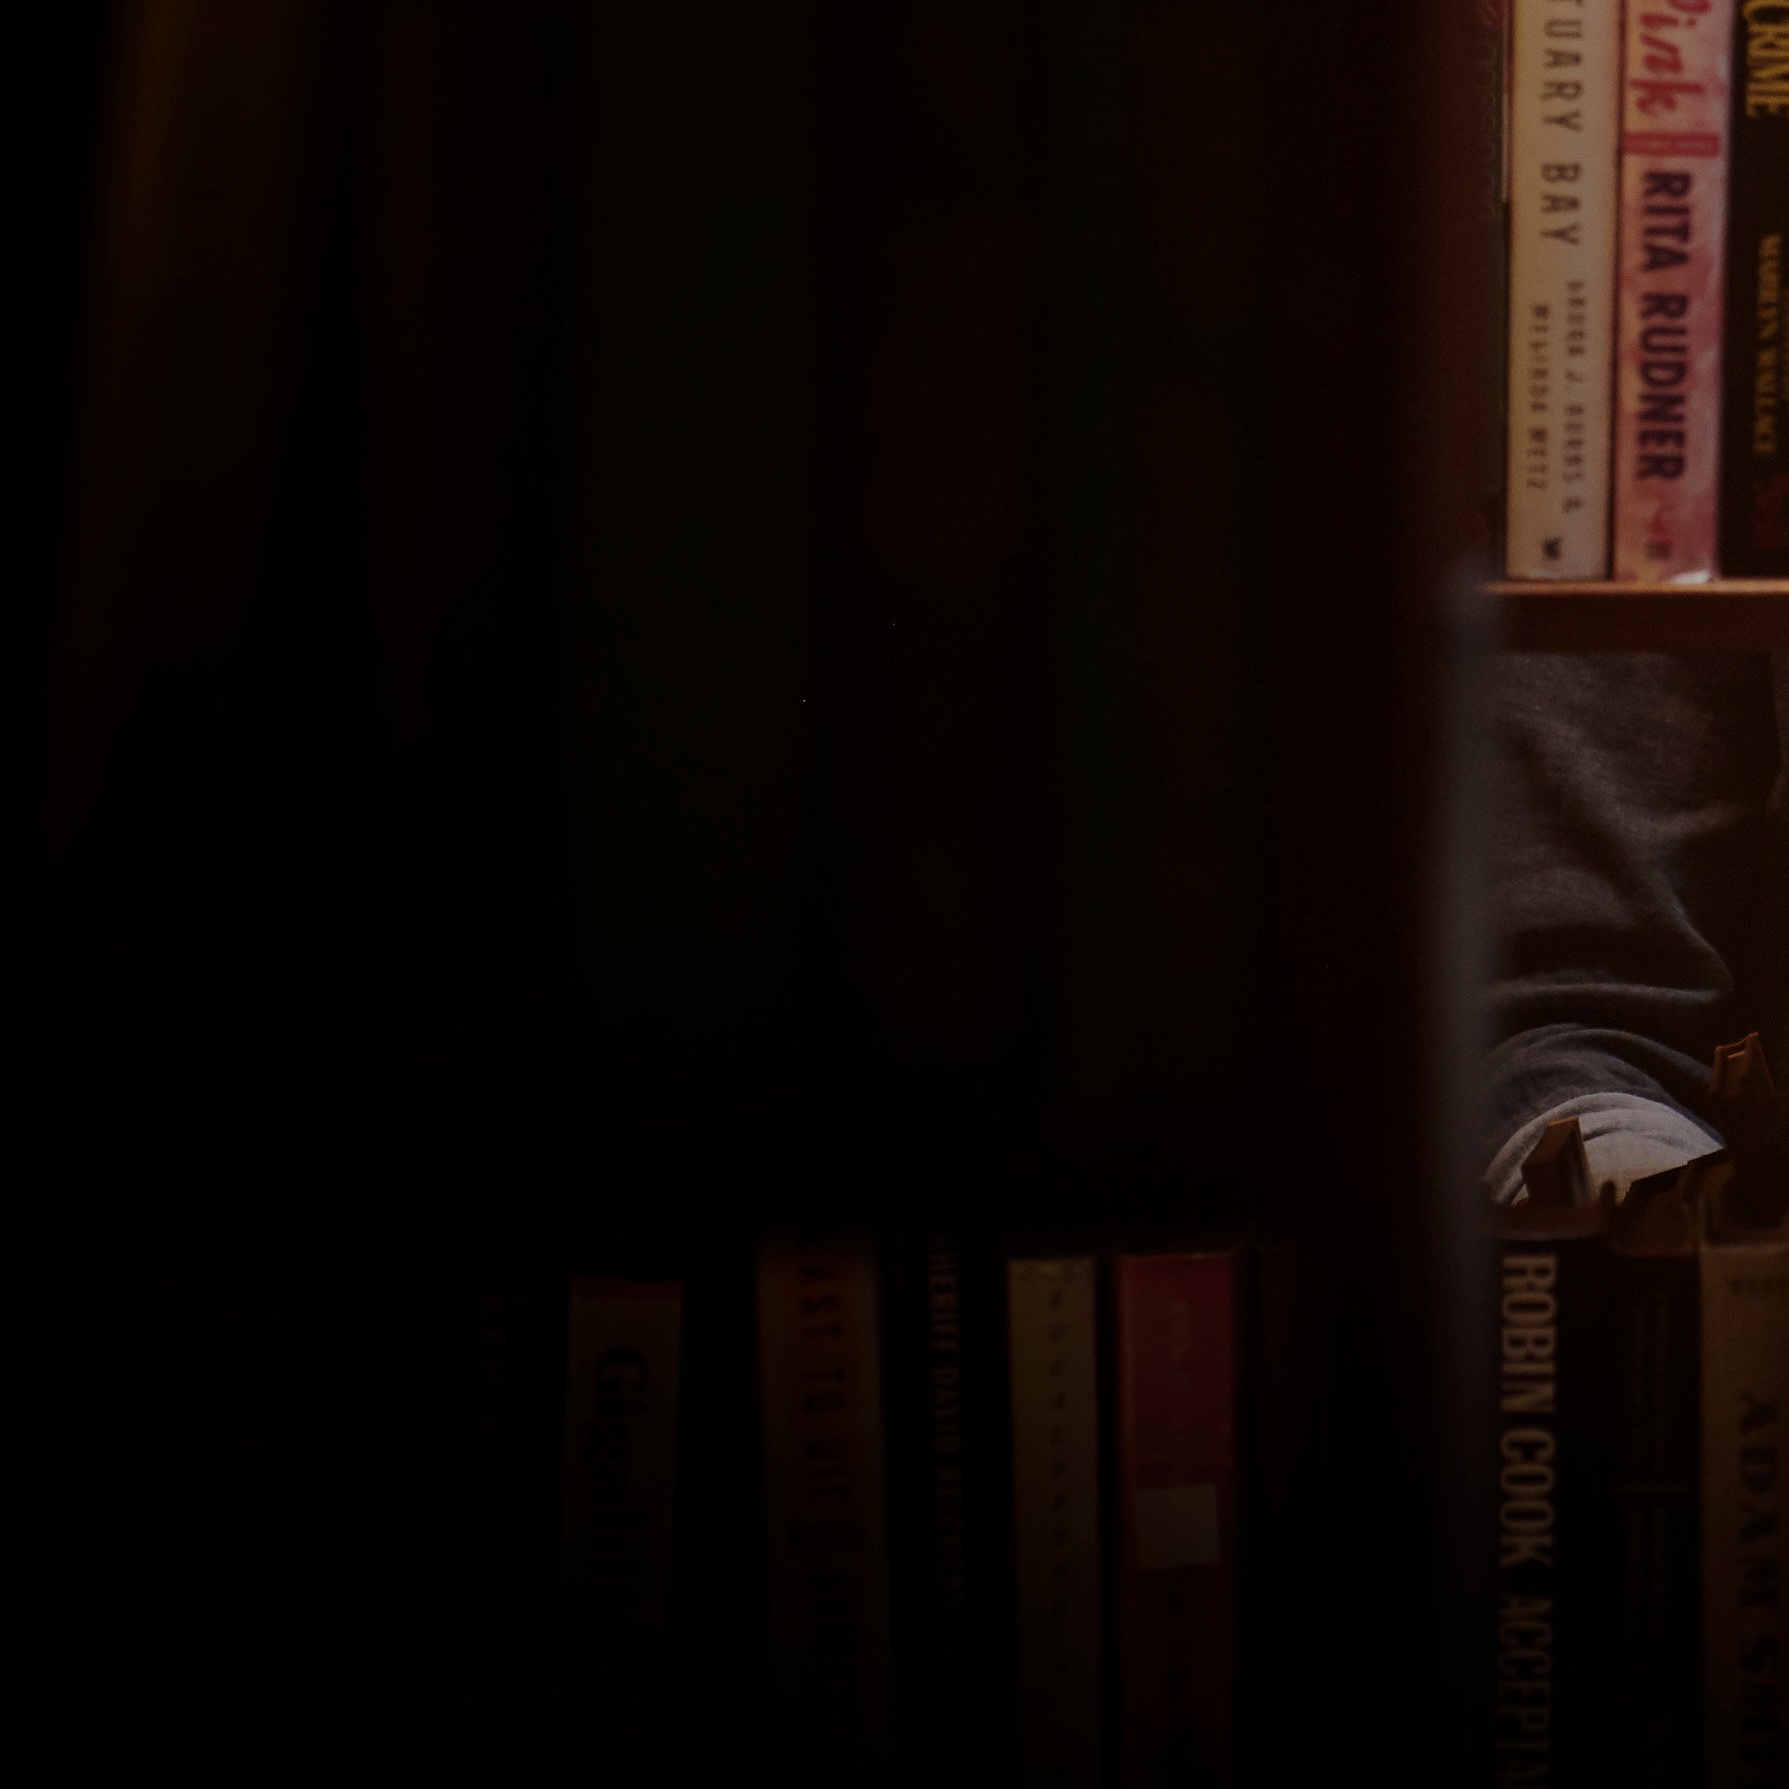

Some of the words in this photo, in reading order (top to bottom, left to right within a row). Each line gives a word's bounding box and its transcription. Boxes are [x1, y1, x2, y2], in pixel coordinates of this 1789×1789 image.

[1538, 160, 1583, 248] BAY
[1641, 167, 1694, 273] RITA
[1636, 291, 1689, 481] RUDNER
[1753, 347, 1781, 453] WALLACE
[1500, 1253, 1558, 1414] ROBIN
[930, 1365, 961, 1456] DAVID
[1498, 1427, 1558, 1571] COOK
[1735, 1393, 1779, 1609] ADAM
